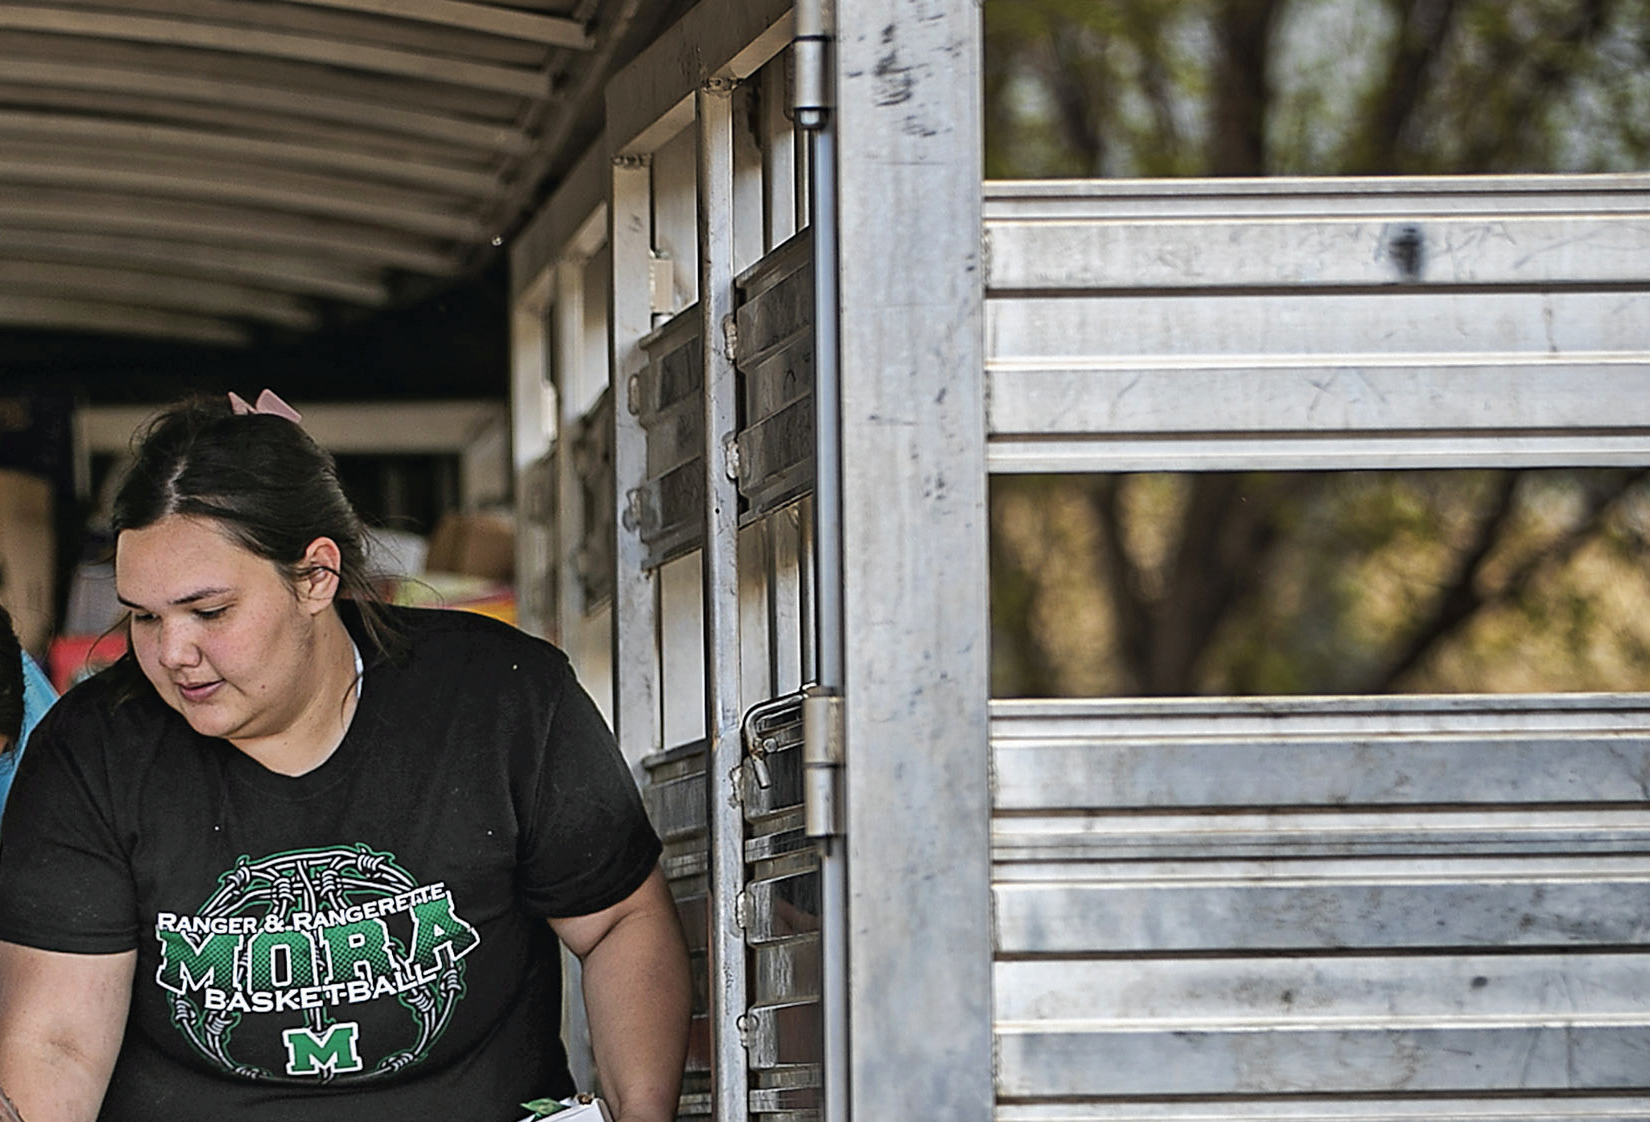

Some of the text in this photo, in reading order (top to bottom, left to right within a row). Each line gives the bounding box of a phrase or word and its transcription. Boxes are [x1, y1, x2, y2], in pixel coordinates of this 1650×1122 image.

[157, 882, 446, 935] RANGER & RANGERETTE
[155, 889, 480, 994] MORA
[204, 967, 438, 1013] BASKETBALL
[282, 1021, 364, 1076] M
